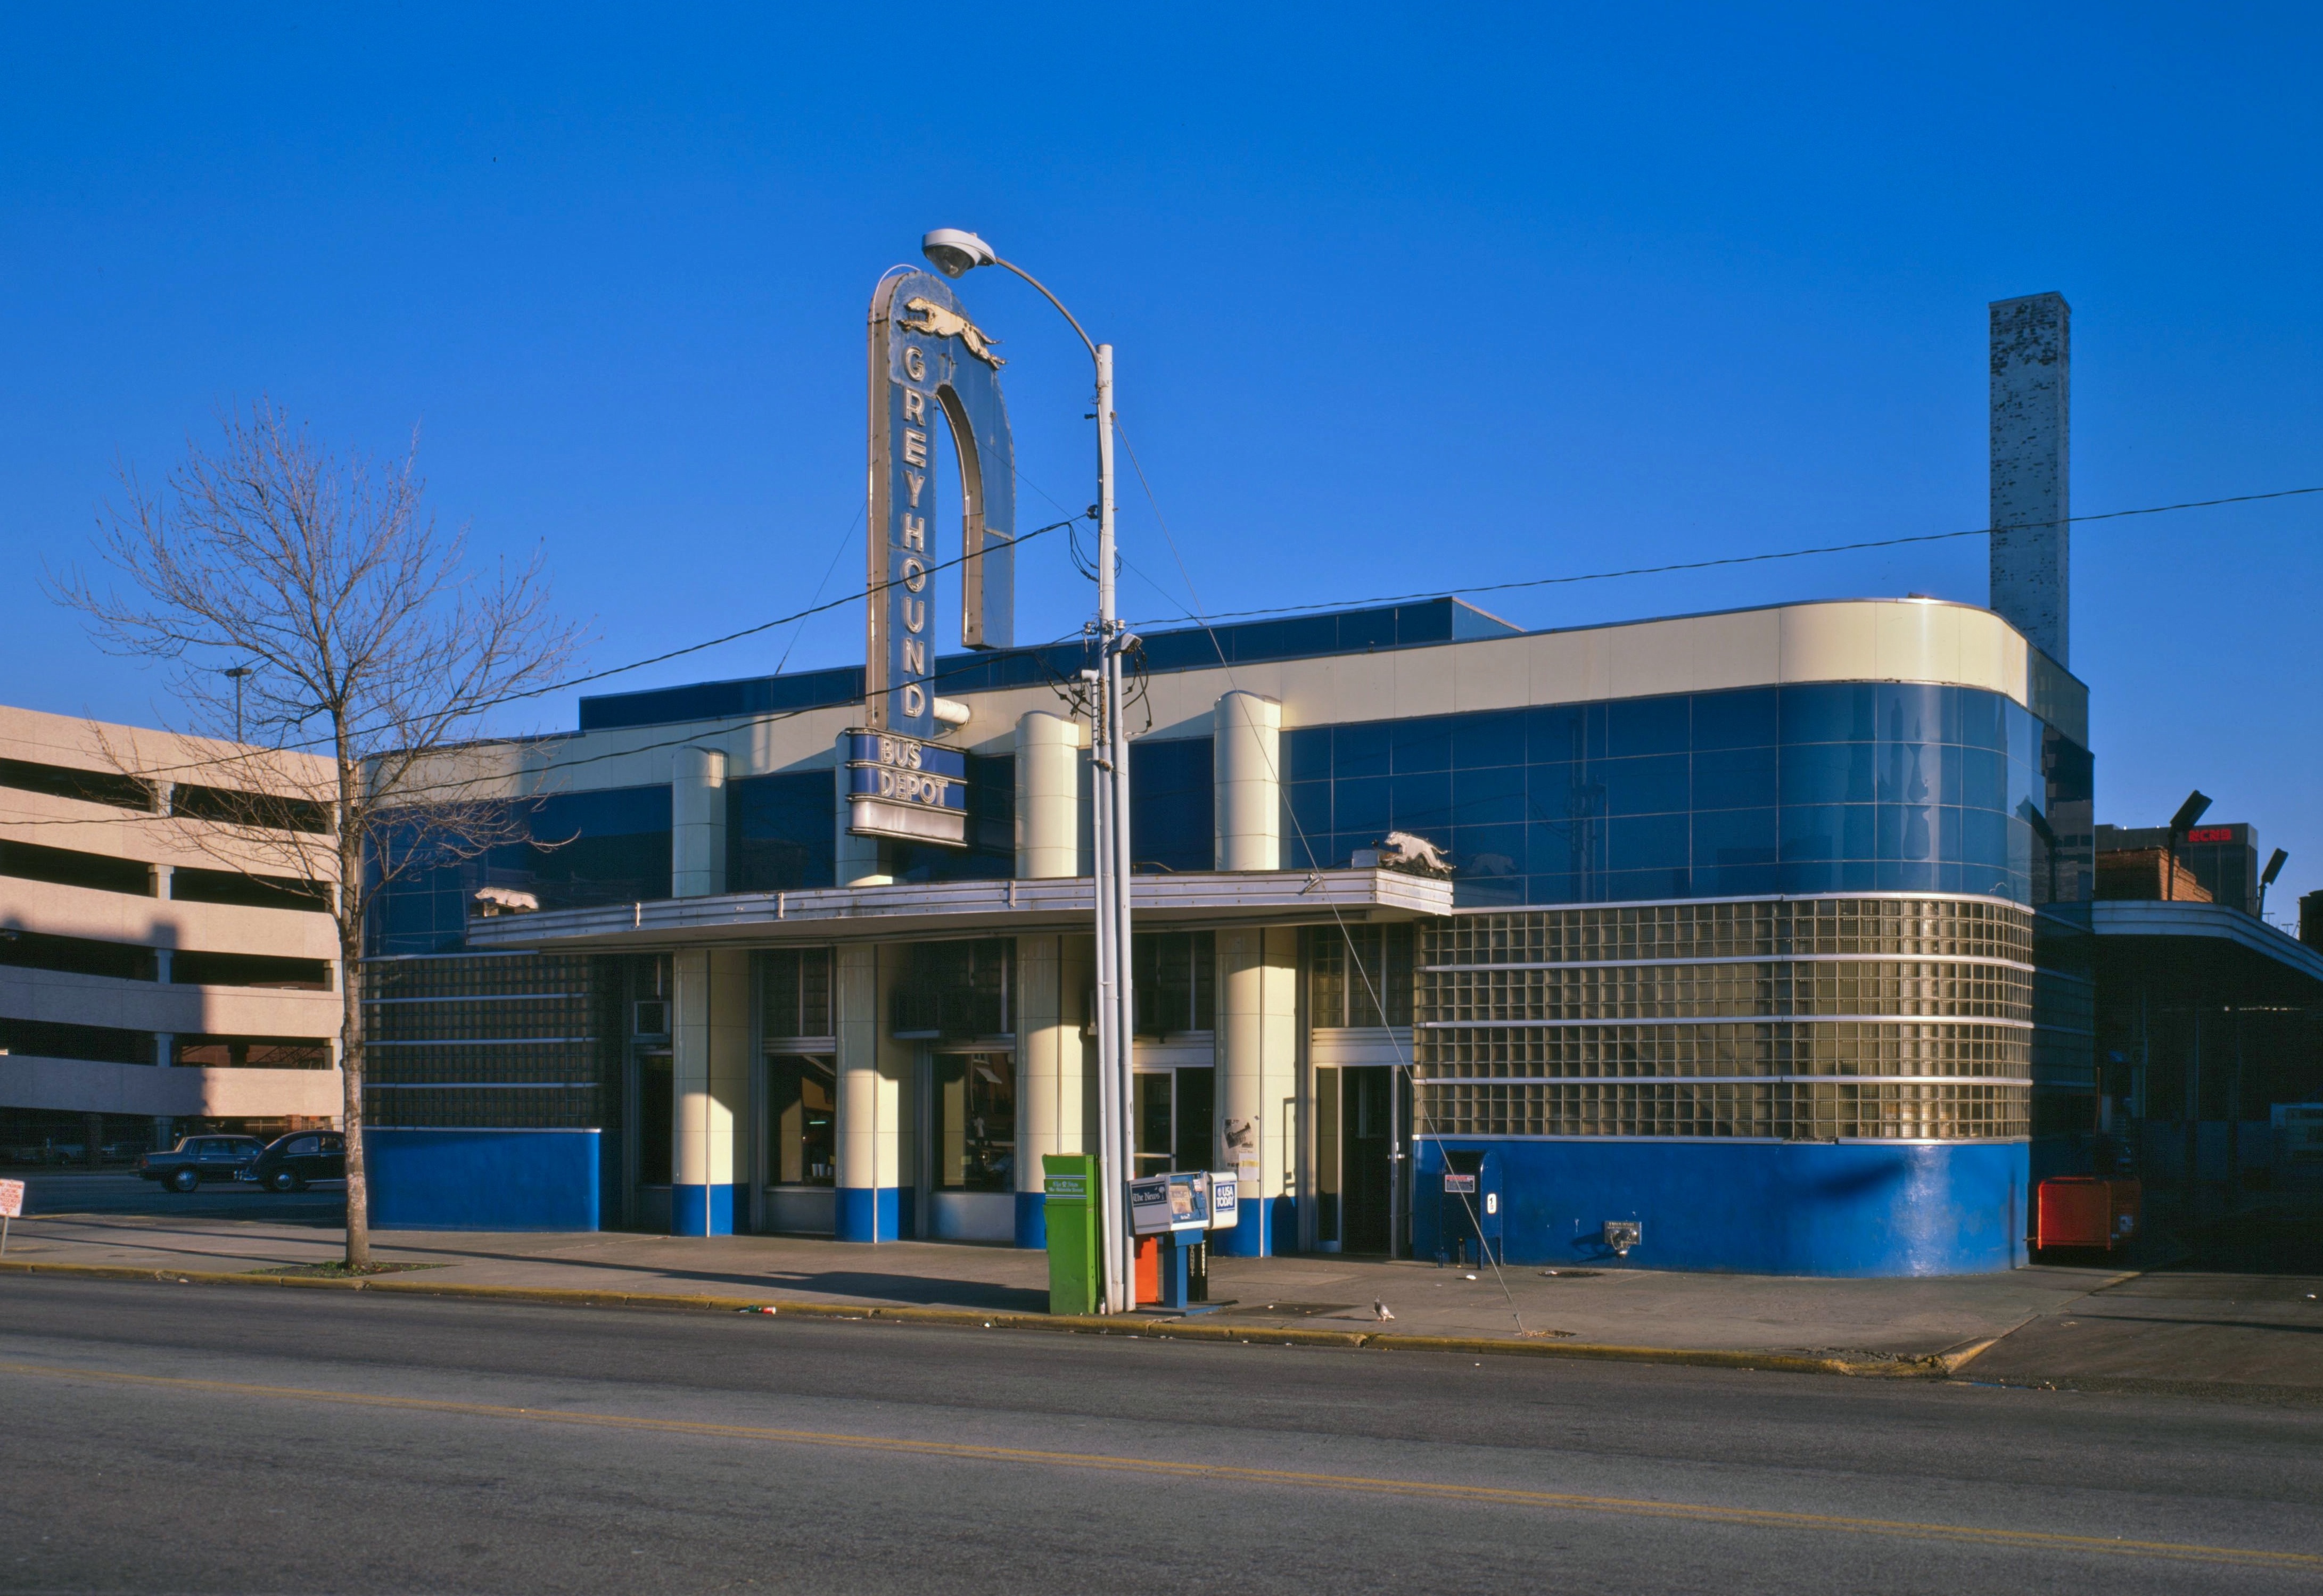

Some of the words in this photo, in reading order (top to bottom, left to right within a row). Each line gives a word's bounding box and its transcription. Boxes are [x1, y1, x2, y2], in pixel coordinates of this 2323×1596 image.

[903, 346, 926, 717] GREYHOUND
[881, 737, 922, 769] BUS
[881, 771, 948, 807] DEPOT
[1133, 1193, 1144, 1202] The
[1144, 1192, 1160, 1201] News
[1216, 1196, 1234, 1207] TODAY
[1222, 1187, 1233, 1196] USA
